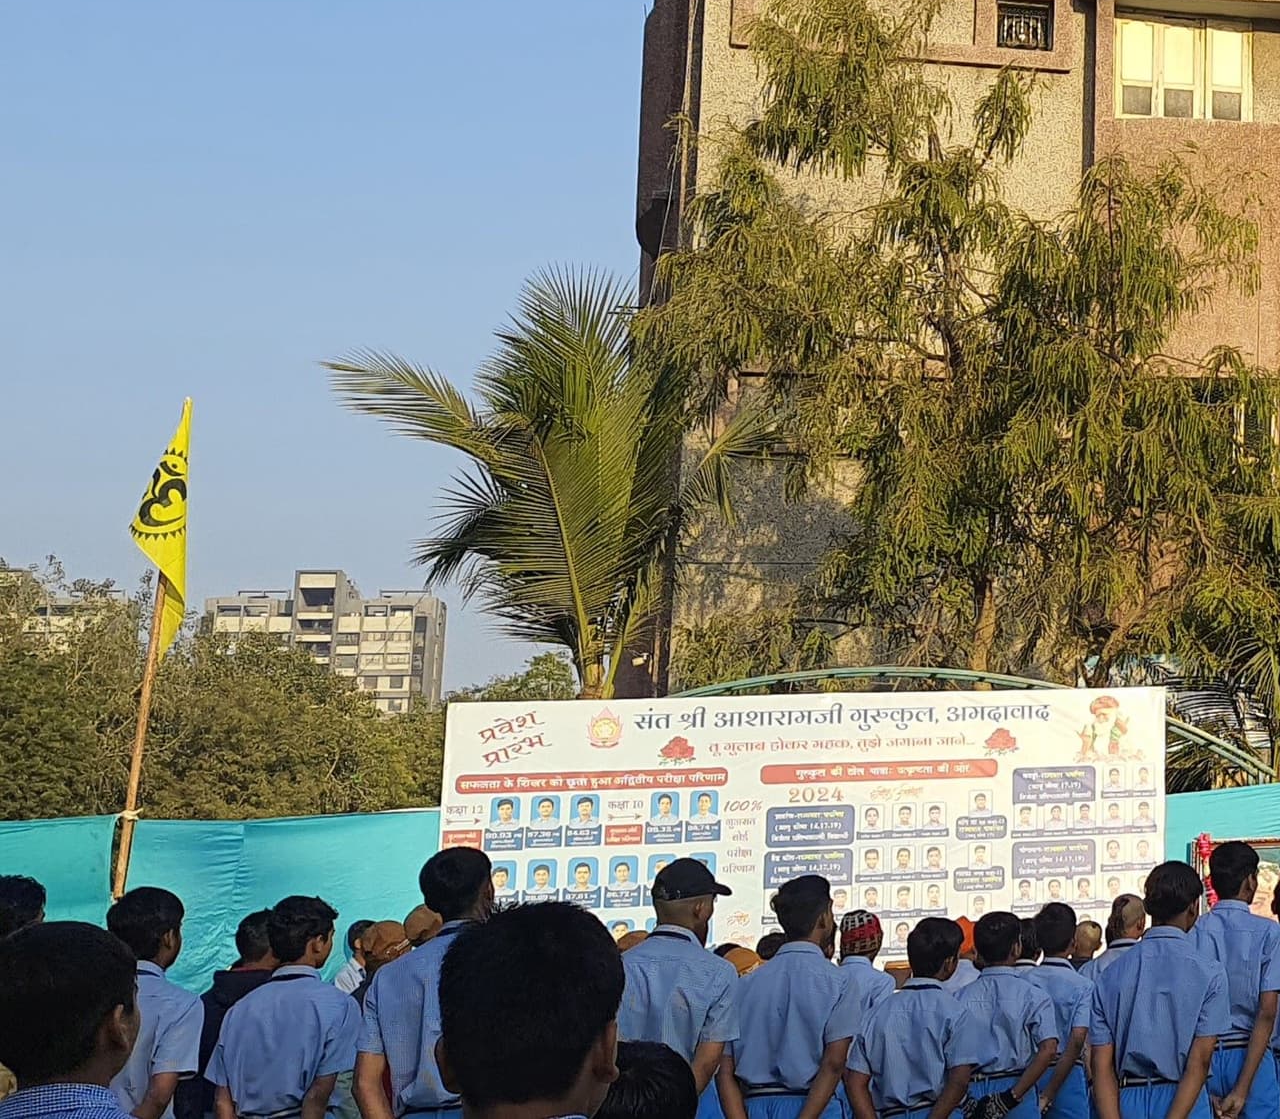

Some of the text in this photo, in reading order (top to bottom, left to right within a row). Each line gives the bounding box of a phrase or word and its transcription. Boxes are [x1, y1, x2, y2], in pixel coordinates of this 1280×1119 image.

[633, 708, 673, 730] संत
[677, 705, 706, 731] श्री
[714, 702, 844, 729] आशारामजी
[849, 706, 939, 732] गुरुकुल,
[478, 710, 546, 745] प्रवेश
[481, 732, 553, 769] प्रारंभ
[708, 742, 722, 757] तू
[723, 741, 766, 757] गुलाब
[460, 778, 501, 791] सफलता
[688, 770, 726, 783] परिणाम
[788, 786, 845, 803] 2024
[471, 804, 484, 814] 12
[723, 800, 764, 813] 100%
